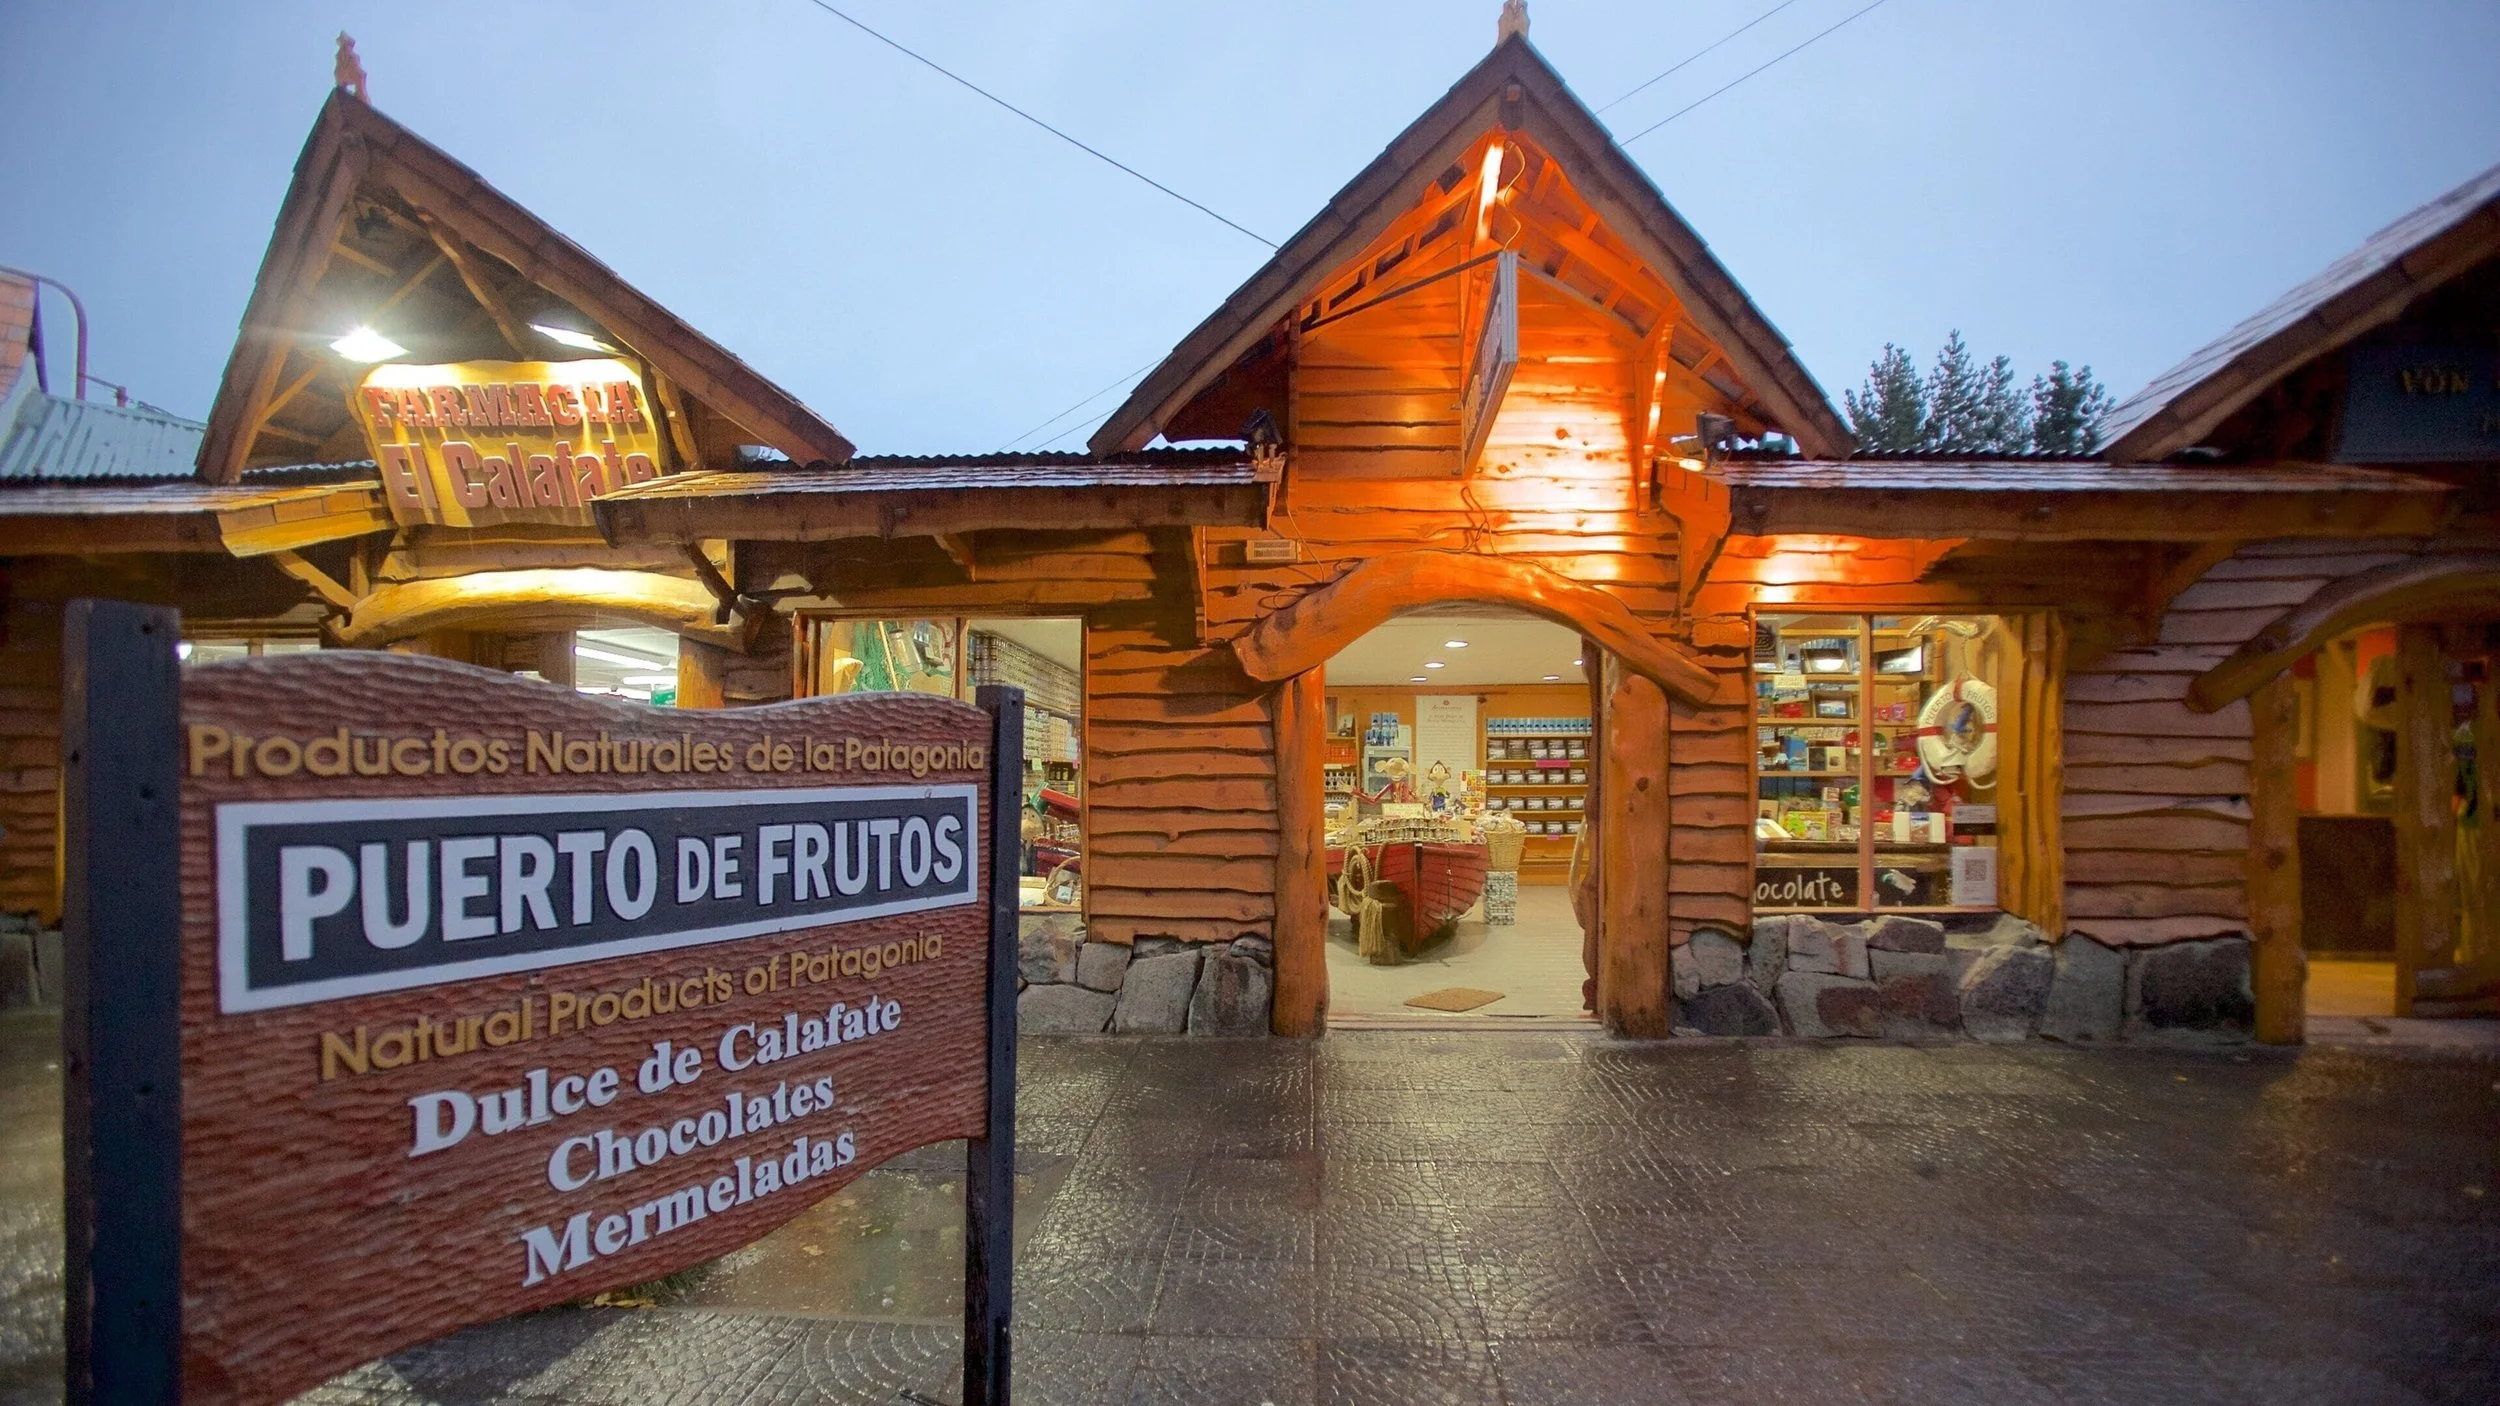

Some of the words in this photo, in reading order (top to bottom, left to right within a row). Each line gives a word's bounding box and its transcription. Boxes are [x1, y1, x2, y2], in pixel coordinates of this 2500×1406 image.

[363, 381, 640, 428] FARMACIA
[381, 443, 438, 508] El
[441, 440, 652, 508] Calafate
[189, 724, 510, 778] Productos
[525, 730, 735, 774] Naturales
[747, 734, 794, 773] de
[805, 736, 835, 771] la
[845, 737, 985, 778] Patagonia
[1926, 692, 1952, 725] PUERTO
[1967, 690, 1995, 720] FRUTOS
[280, 828, 658, 962] PUERTO
[677, 835, 743, 905] DE
[758, 814, 963, 906] FRUTOS
[1753, 871, 1844, 904] ocolate
[320, 1009, 533, 1082] Natural
[548, 966, 733, 1036] Products
[744, 958, 780, 997] of
[790, 930, 944, 987] Patagonia
[407, 1066, 619, 1158] Dulce
[638, 1040, 703, 1093] de
[719, 993, 903, 1072] Calafate
[547, 1073, 836, 1194] Chocolates
[521, 1126, 857, 1288] Mermeladas
